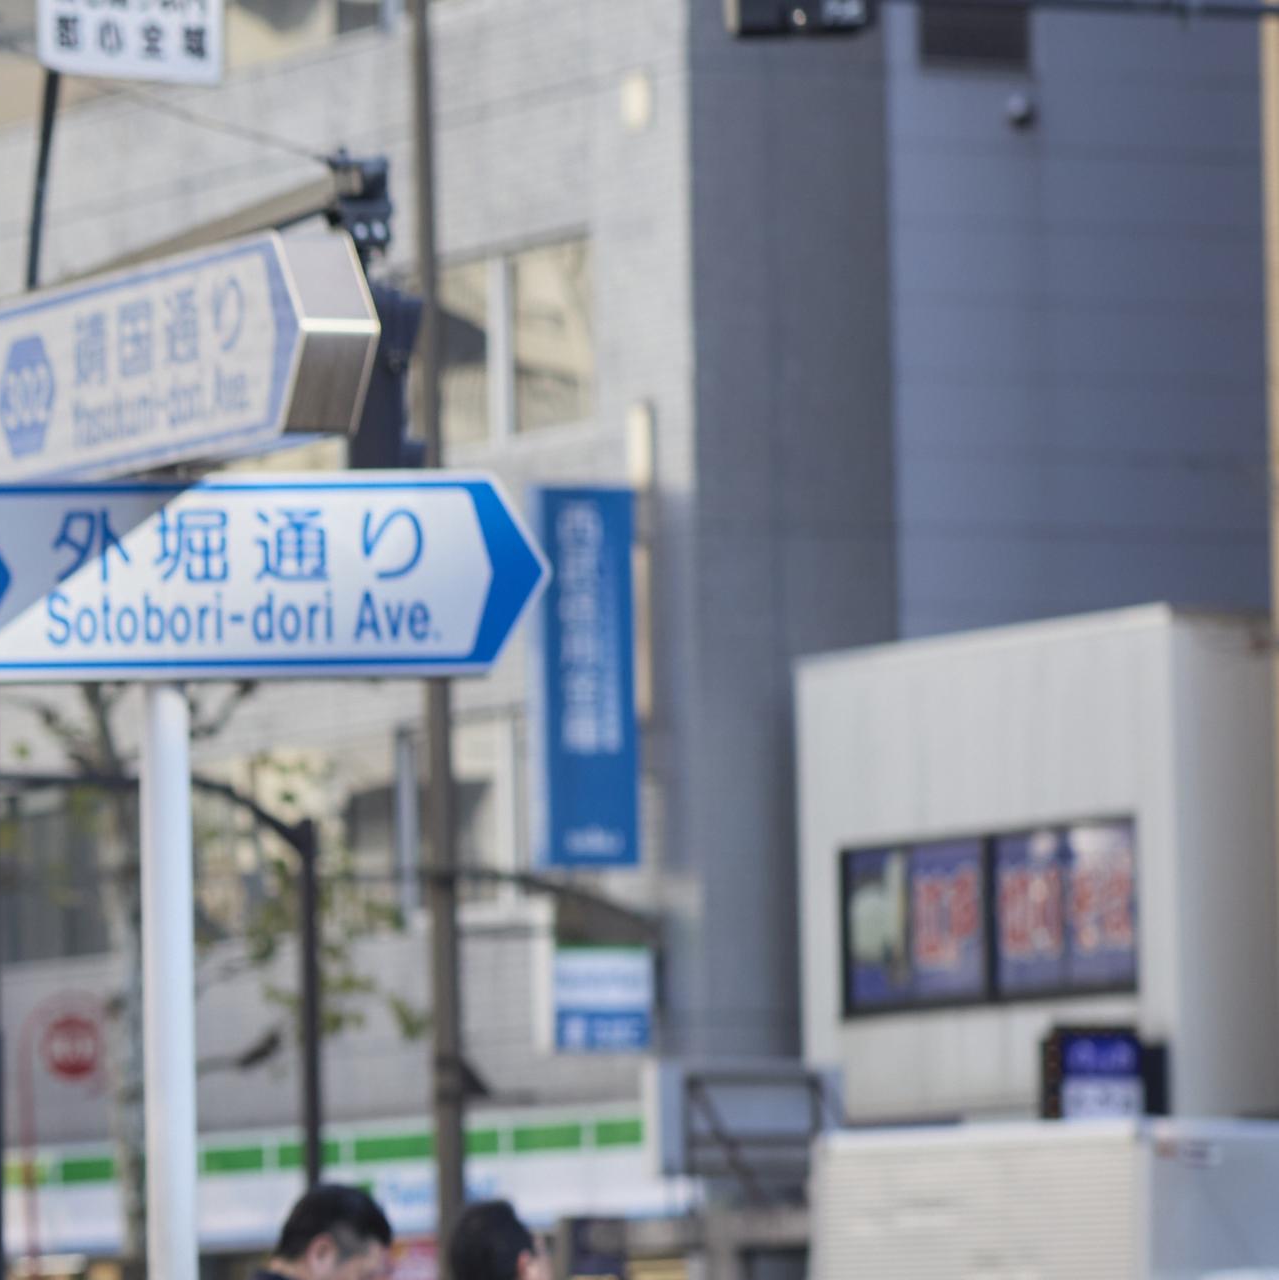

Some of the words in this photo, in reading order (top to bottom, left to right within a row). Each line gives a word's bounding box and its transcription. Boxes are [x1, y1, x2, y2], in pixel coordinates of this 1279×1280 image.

[74, 275, 245, 384] 靖国通り
[3, 362, 50, 432] 302
[53, 506, 425, 584] 外堀通り
[47, 592, 334, 647] Sotobori-dori
[354, 592, 442, 643] Ave.
